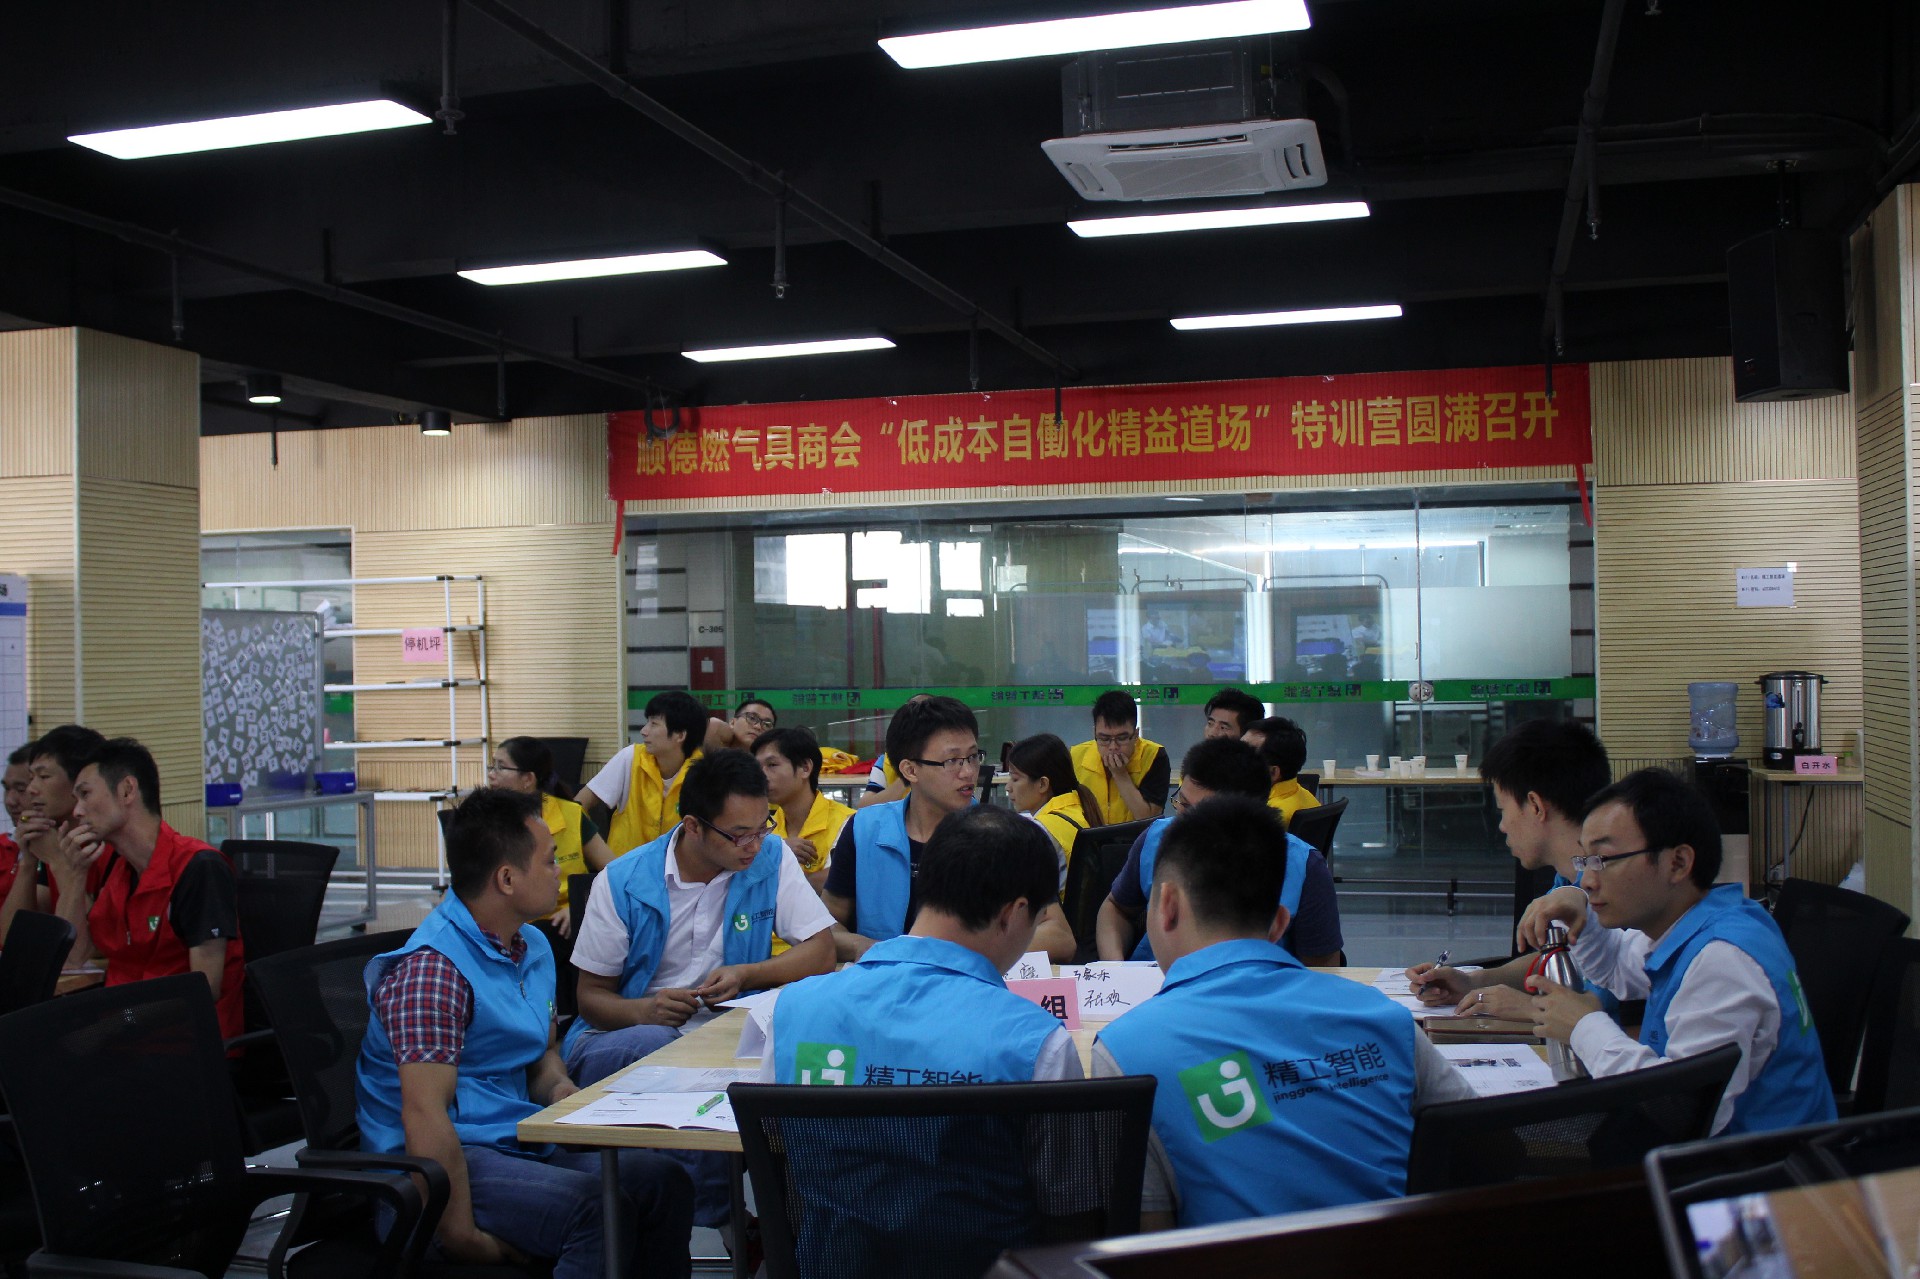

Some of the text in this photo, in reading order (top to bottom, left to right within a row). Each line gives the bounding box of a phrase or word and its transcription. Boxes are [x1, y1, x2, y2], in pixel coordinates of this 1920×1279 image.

[637, 421, 862, 476] 顺德燃气具商会
[1290, 390, 1559, 450] 特训营圆满召开
[404, 636, 441, 651] 停机坪
[1801, 761, 1831, 770] 白开水
[1040, 995, 1069, 1020] 组
[1262, 1042, 1387, 1089] 精工智能
[1273, 1085, 1323, 1104] jinggon
